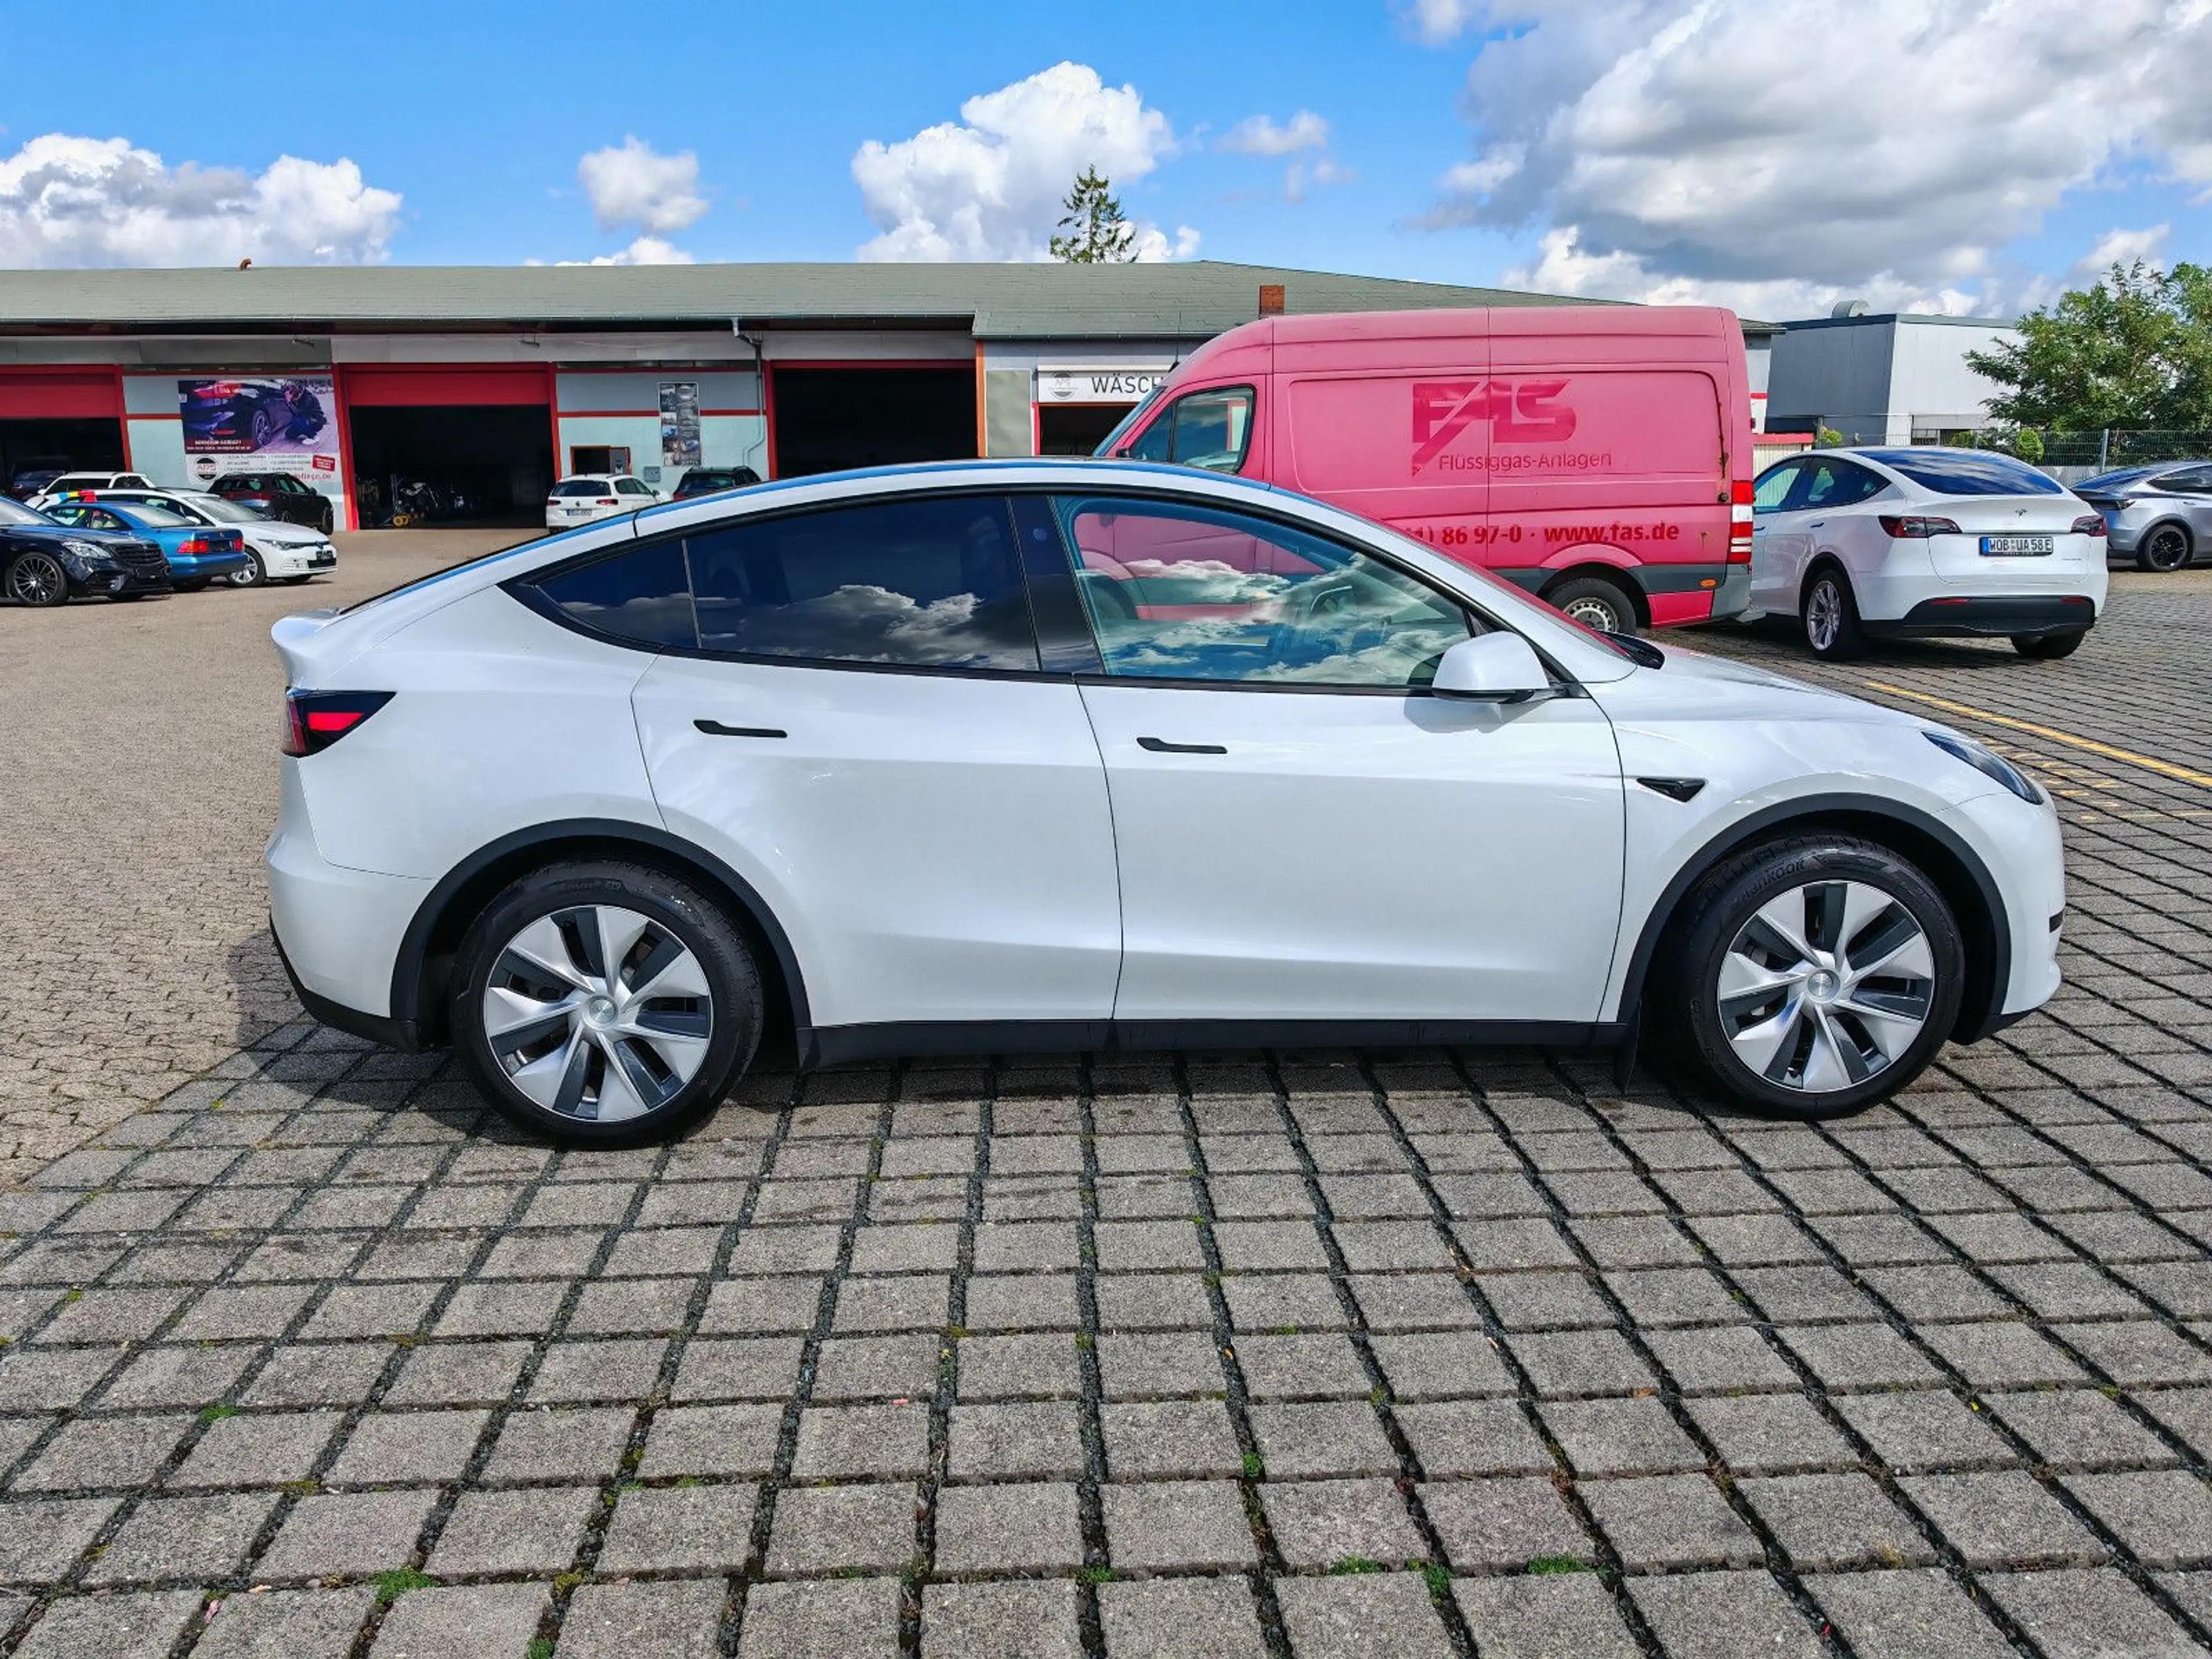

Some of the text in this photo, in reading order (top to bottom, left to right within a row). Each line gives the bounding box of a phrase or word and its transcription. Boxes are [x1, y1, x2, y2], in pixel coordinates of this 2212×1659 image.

[1412, 378, 1577, 478] FAS
[1439, 451, 1612, 471] Flüssiggas-Anlagen
[1442, 525, 1468, 545] 86
[1474, 524, 1522, 544] 97-0
[1544, 521, 1680, 542] www.fas.de
[1989, 539, 2009, 551] WOB
[2016, 539, 2030, 551] UA
